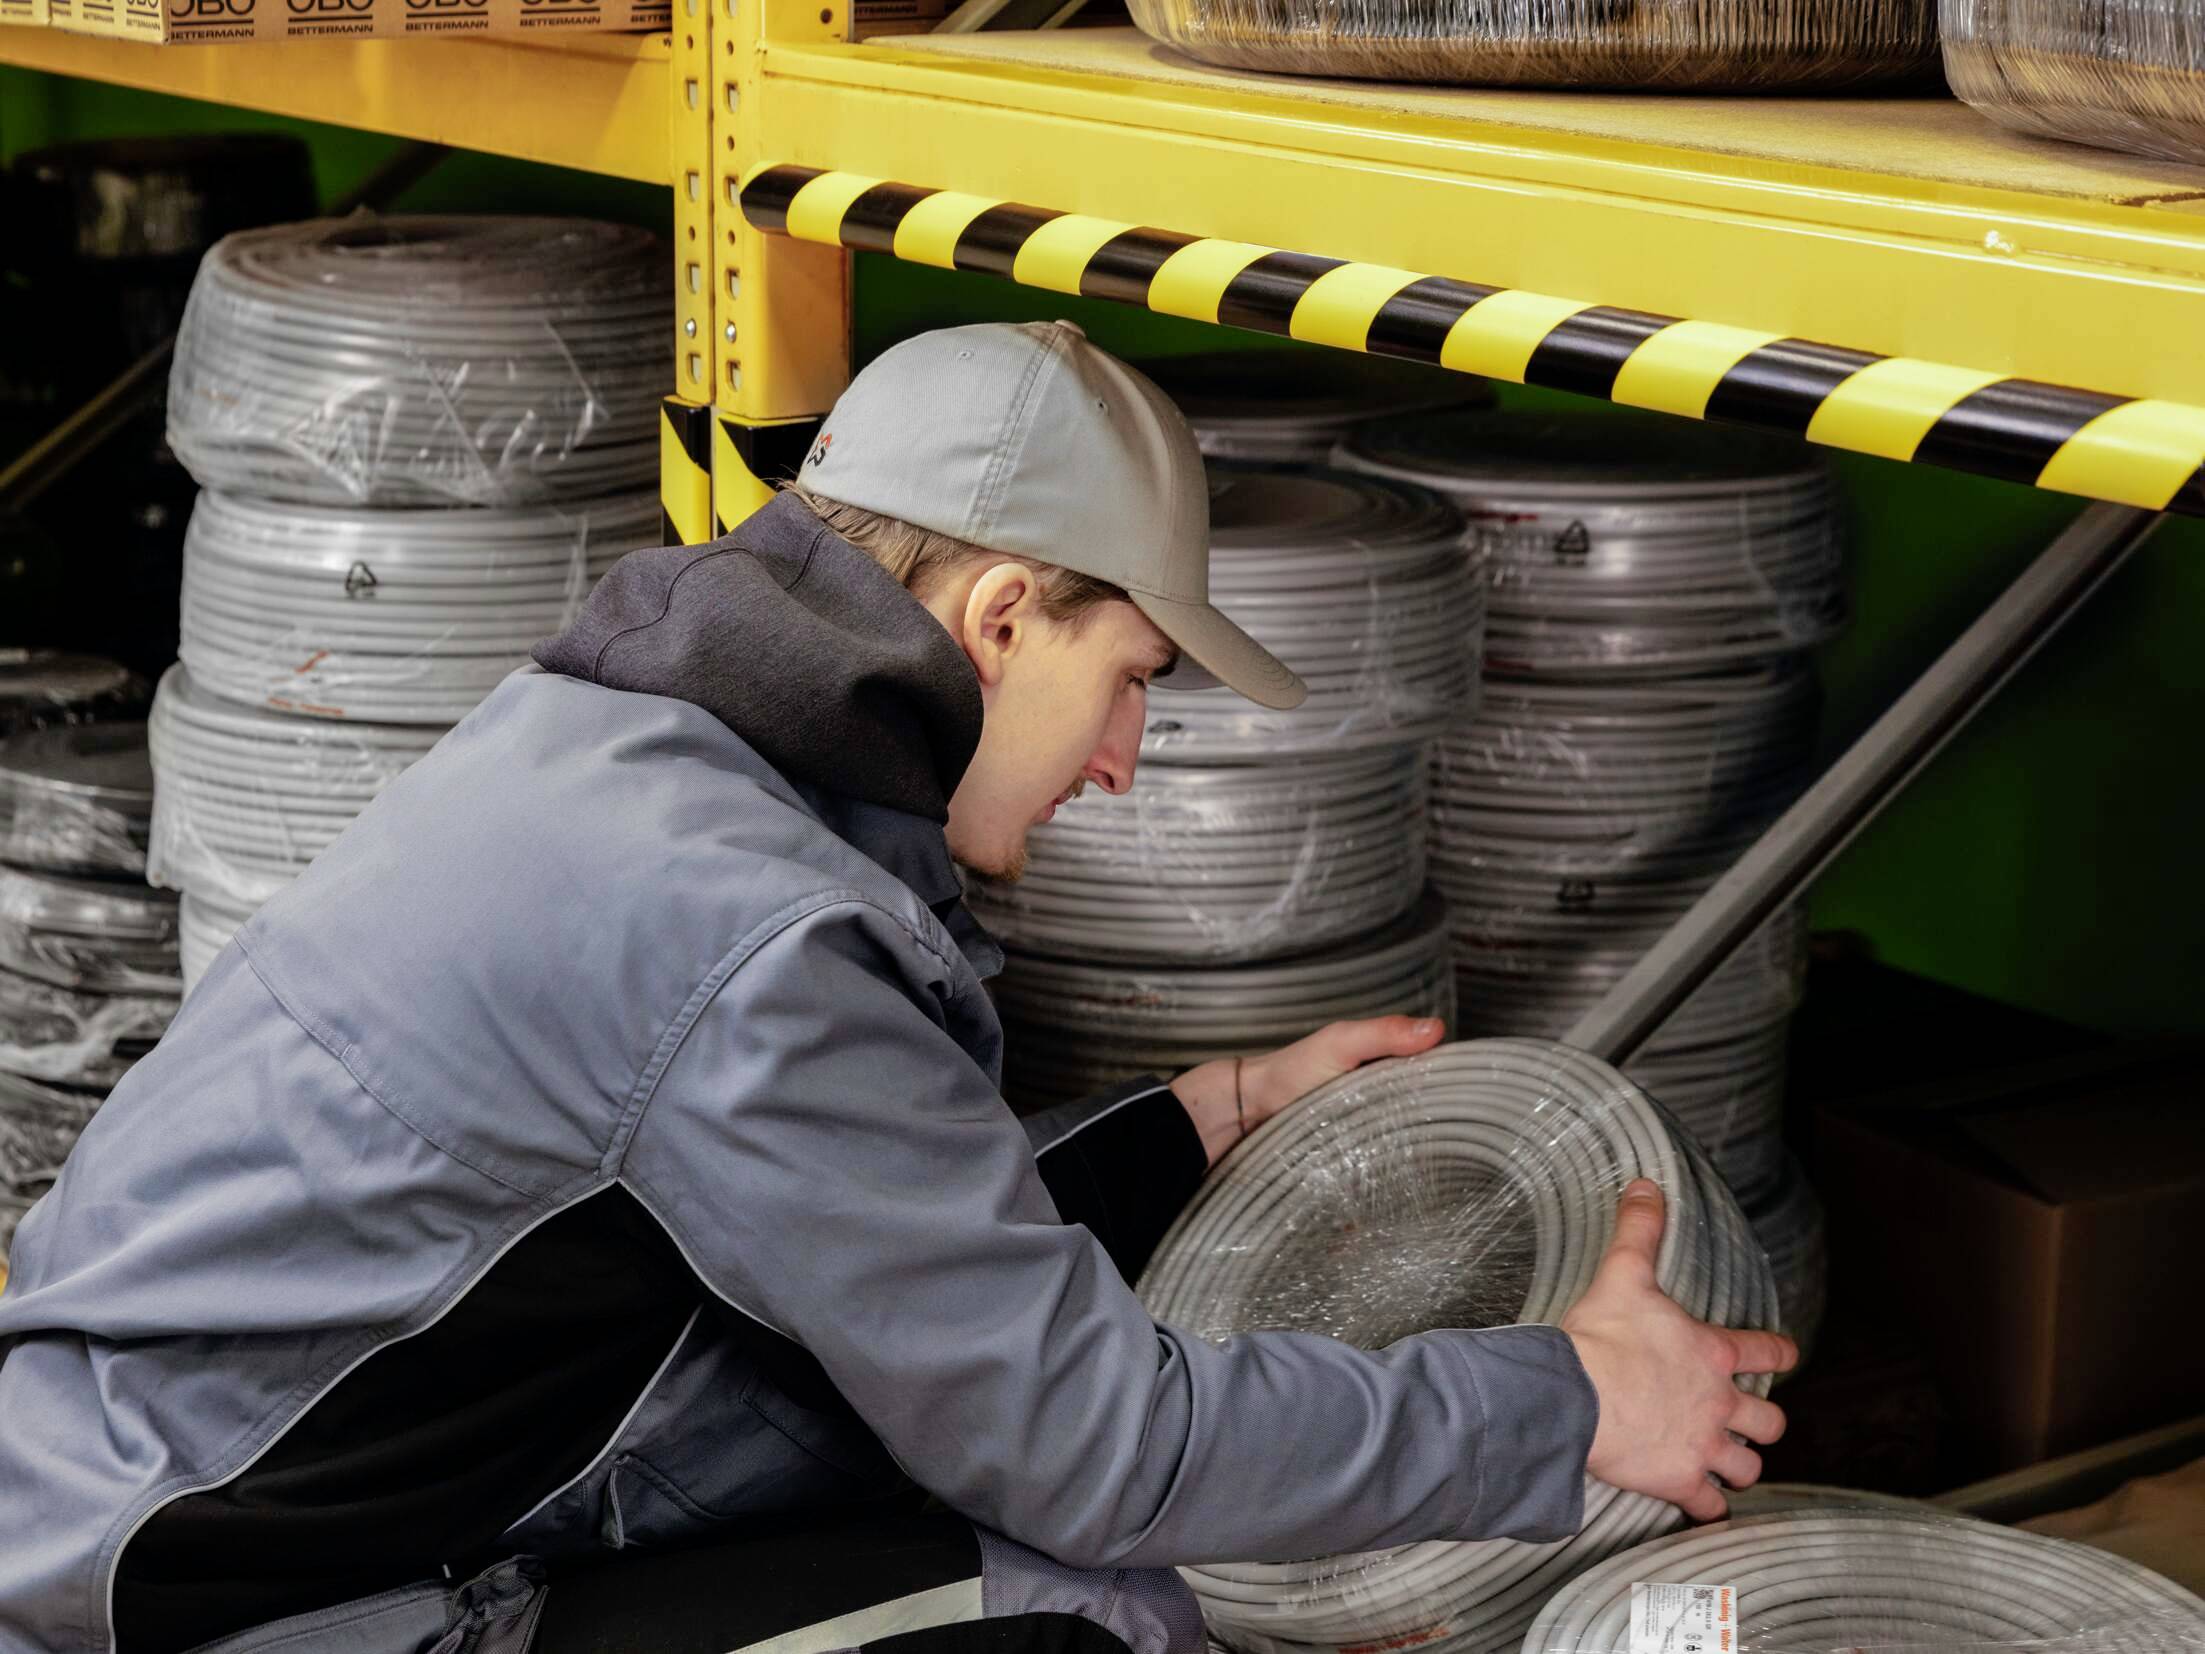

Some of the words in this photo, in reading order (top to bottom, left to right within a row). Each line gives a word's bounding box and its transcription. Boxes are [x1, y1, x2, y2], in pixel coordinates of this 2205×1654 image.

[405, 20, 489, 31] BETTERMANN
[519, 16, 600, 27] BETTERMANN
[287, 24, 374, 35] BETTERMANN
